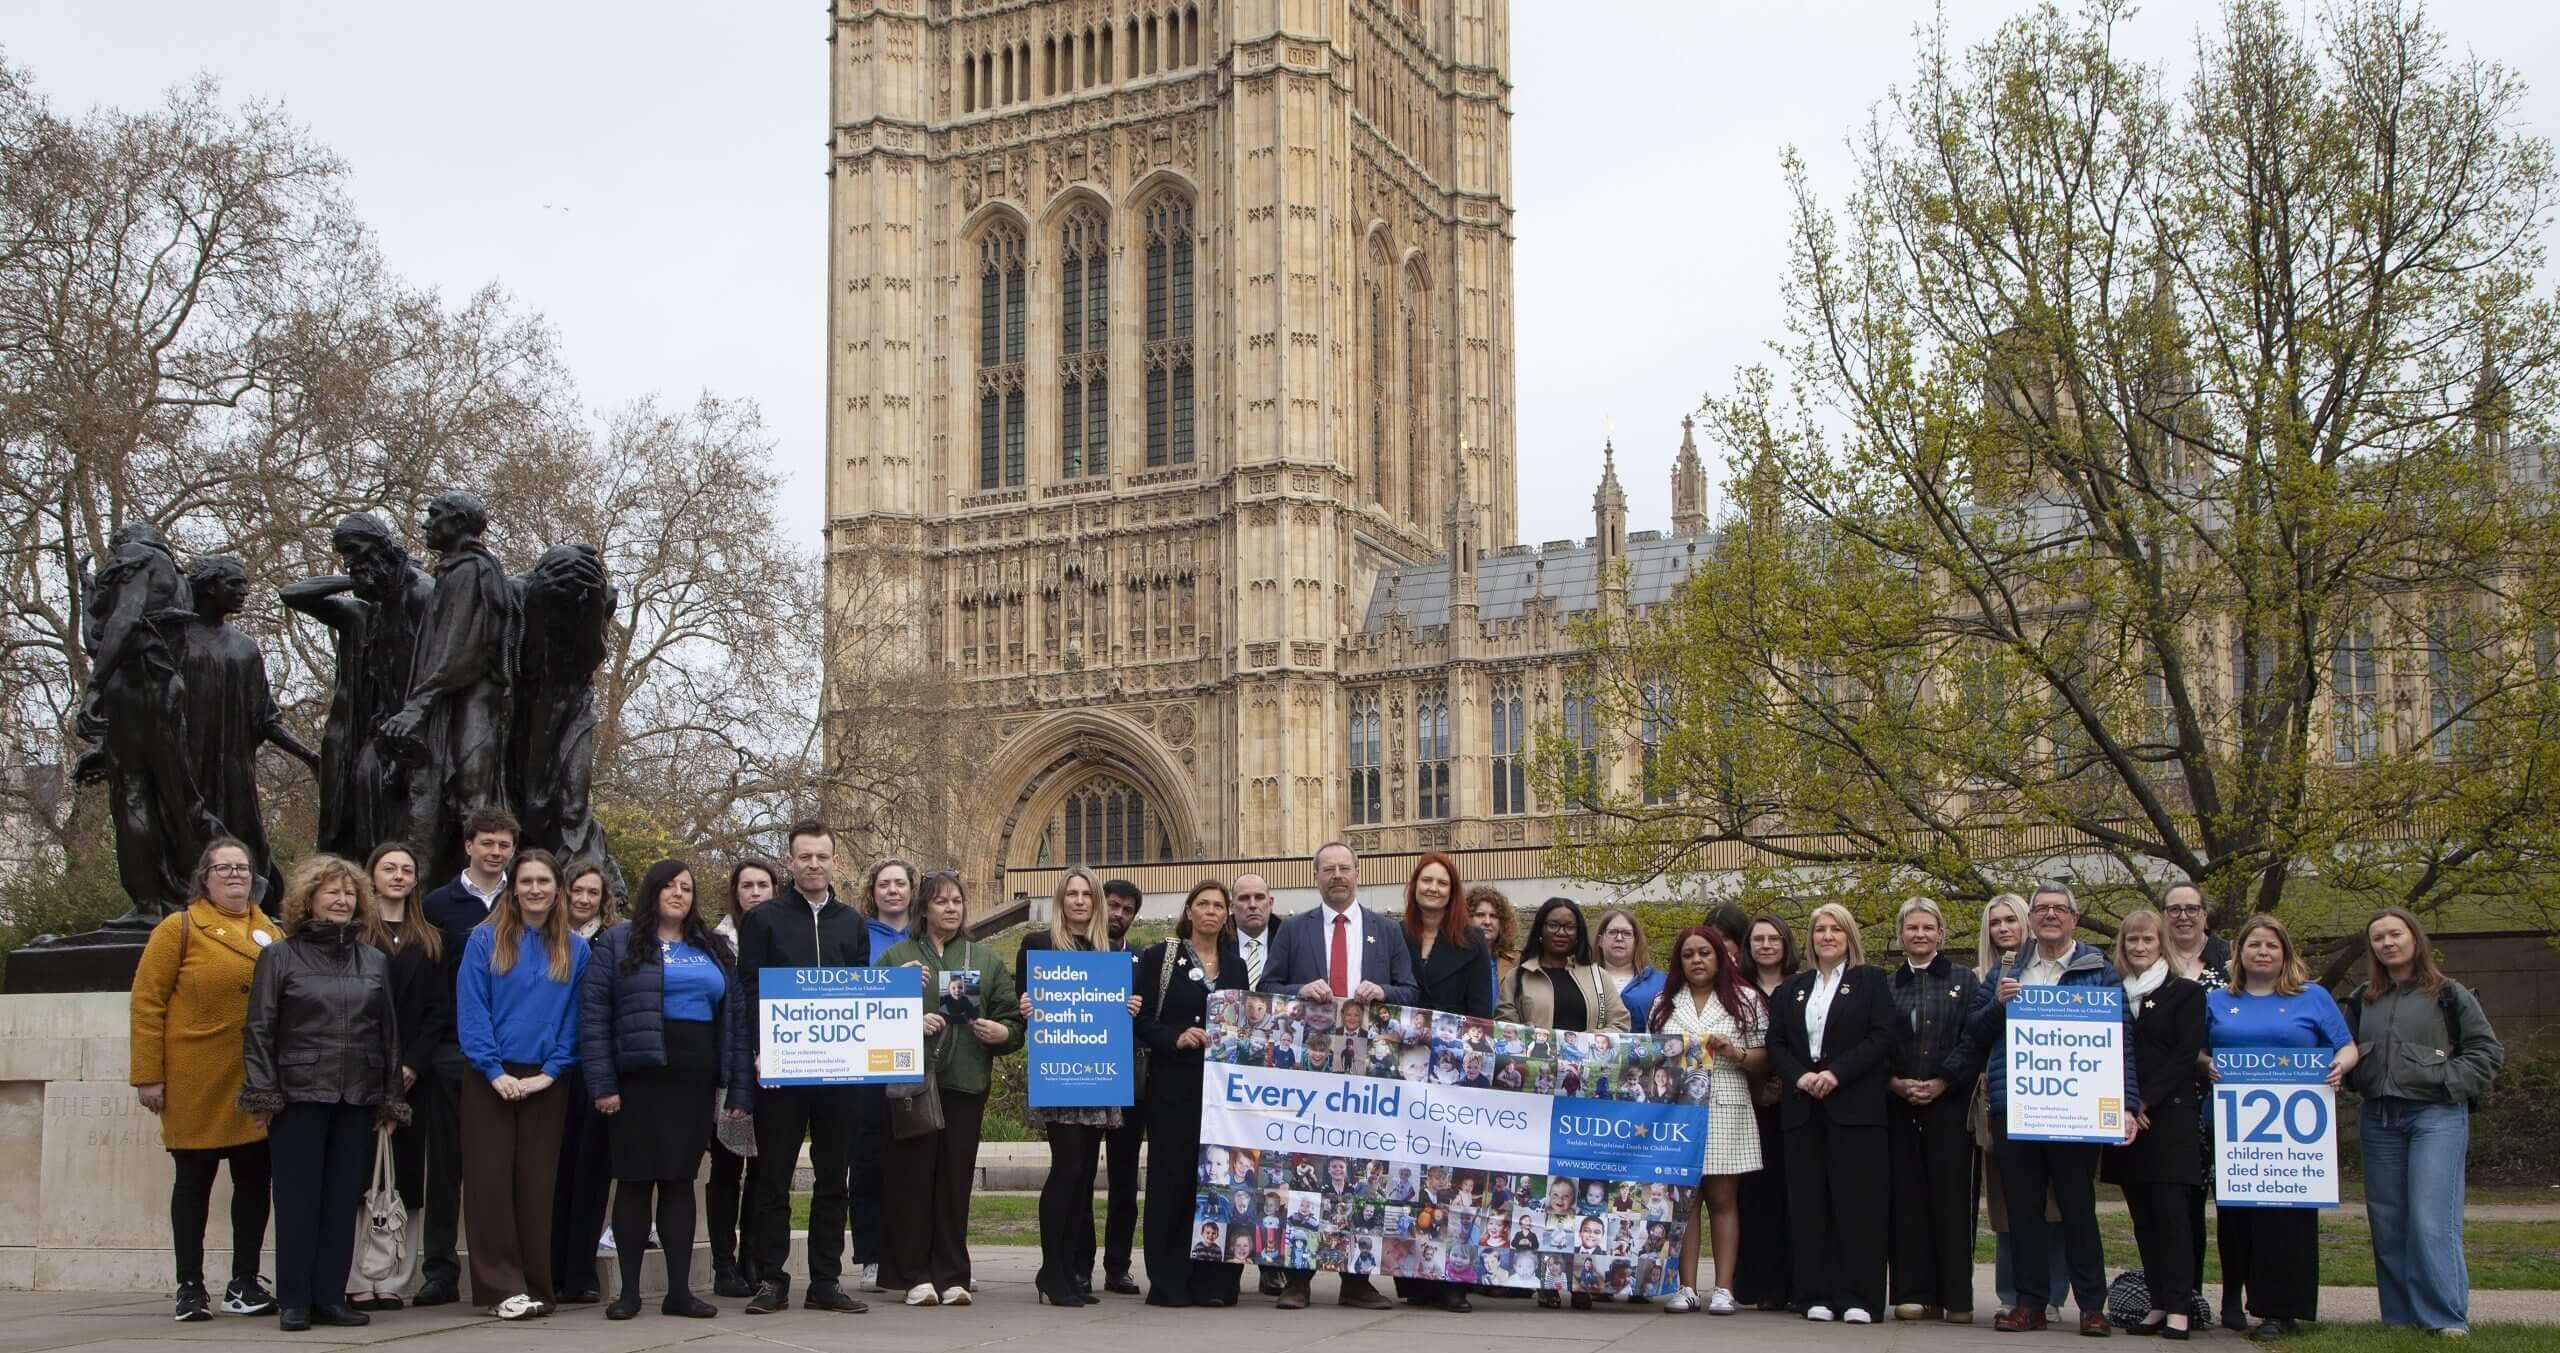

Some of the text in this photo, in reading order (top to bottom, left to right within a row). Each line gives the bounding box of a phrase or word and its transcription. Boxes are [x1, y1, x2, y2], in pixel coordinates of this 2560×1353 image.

[796, 969, 892, 984] SUDC UK
[1033, 965, 1088, 981] Sudden
[1034, 987, 1125, 1005] Unexplained
[2013, 988, 2118, 1006] SUDC UK
[771, 1001, 908, 1021] National Plan
[1034, 1008, 1093, 1023] Death in
[773, 1024, 866, 1043] for SUDC
[1034, 1029, 1107, 1045] Childhood
[2015, 1026, 2111, 1048] National
[1040, 1062, 1118, 1075] SUDC UK
[2015, 1051, 2102, 1072] Plan for
[2217, 1053, 2326, 1069] SUDC UK
[2015, 1076, 2079, 1096] SUDC
[48, 1096, 89, 1117] THE
[1226, 1073, 1528, 1130] Every child deserves
[2217, 1089, 2328, 1144] 120
[1266, 1112, 1482, 1160] a chance to live
[1559, 1114, 1691, 1142] SUDC UK
[2227, 1147, 2324, 1161] children have
[2227, 1164, 2325, 1178] died since the
[2228, 1180, 2308, 1194] last debate
